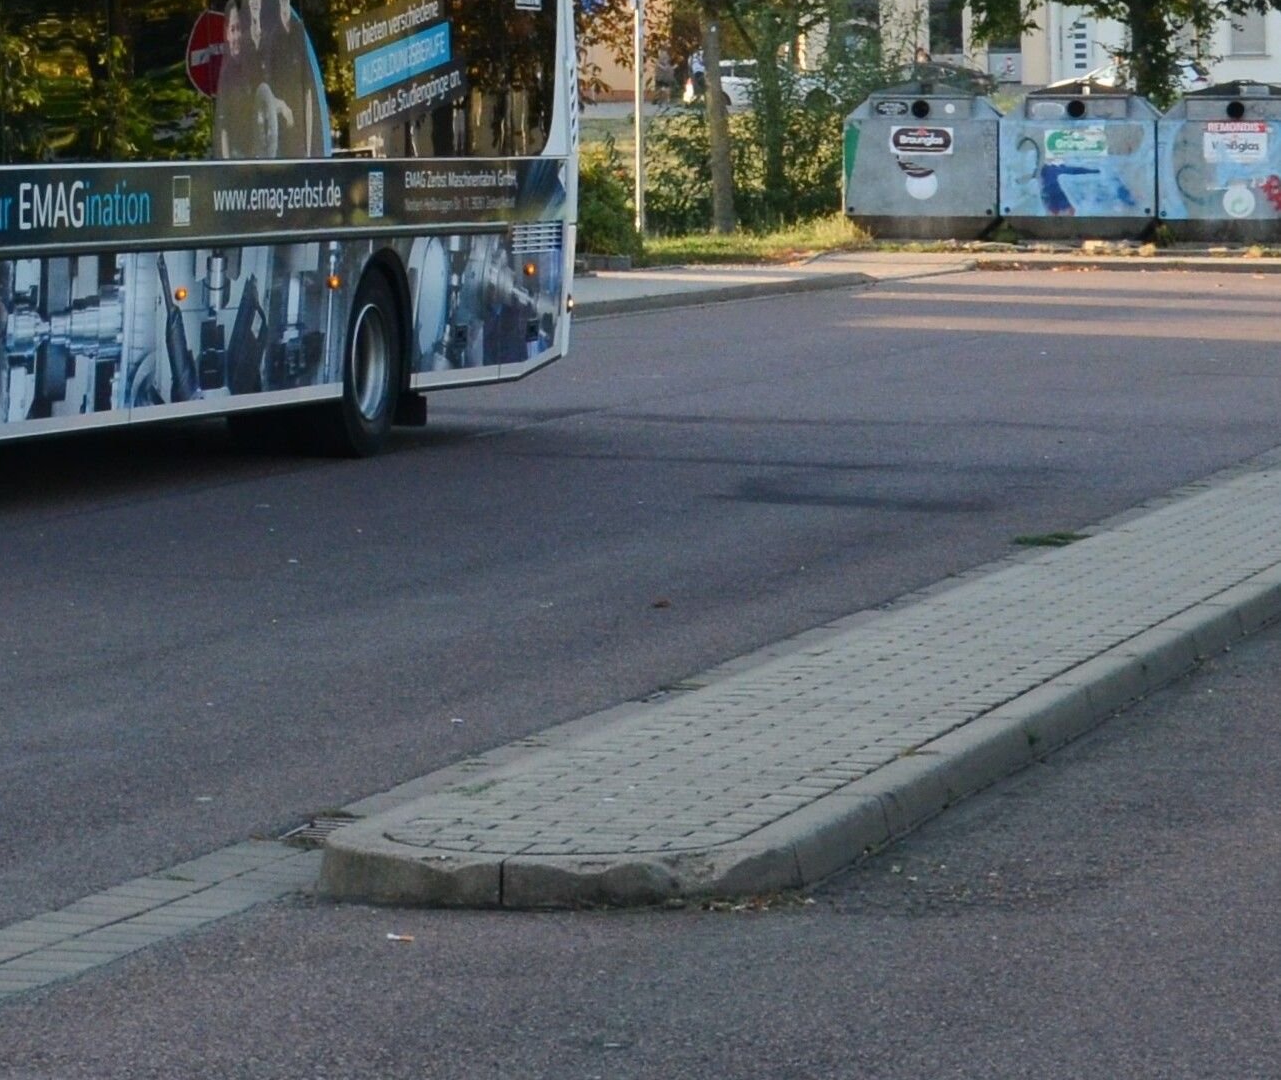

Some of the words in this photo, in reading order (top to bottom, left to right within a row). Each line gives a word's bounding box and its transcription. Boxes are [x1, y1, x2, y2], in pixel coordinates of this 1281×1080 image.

[345, 28, 362, 51] Wir
[362, 20, 388, 45] bieten
[388, 0, 439, 37] verschiedene
[356, 102, 373, 130] und
[373, 92, 397, 123] Duale
[213, 178, 342, 218] www.emag-zerbst.de
[405, 170, 426, 189] EMAG
[18, 180, 151, 230] EMAGination
